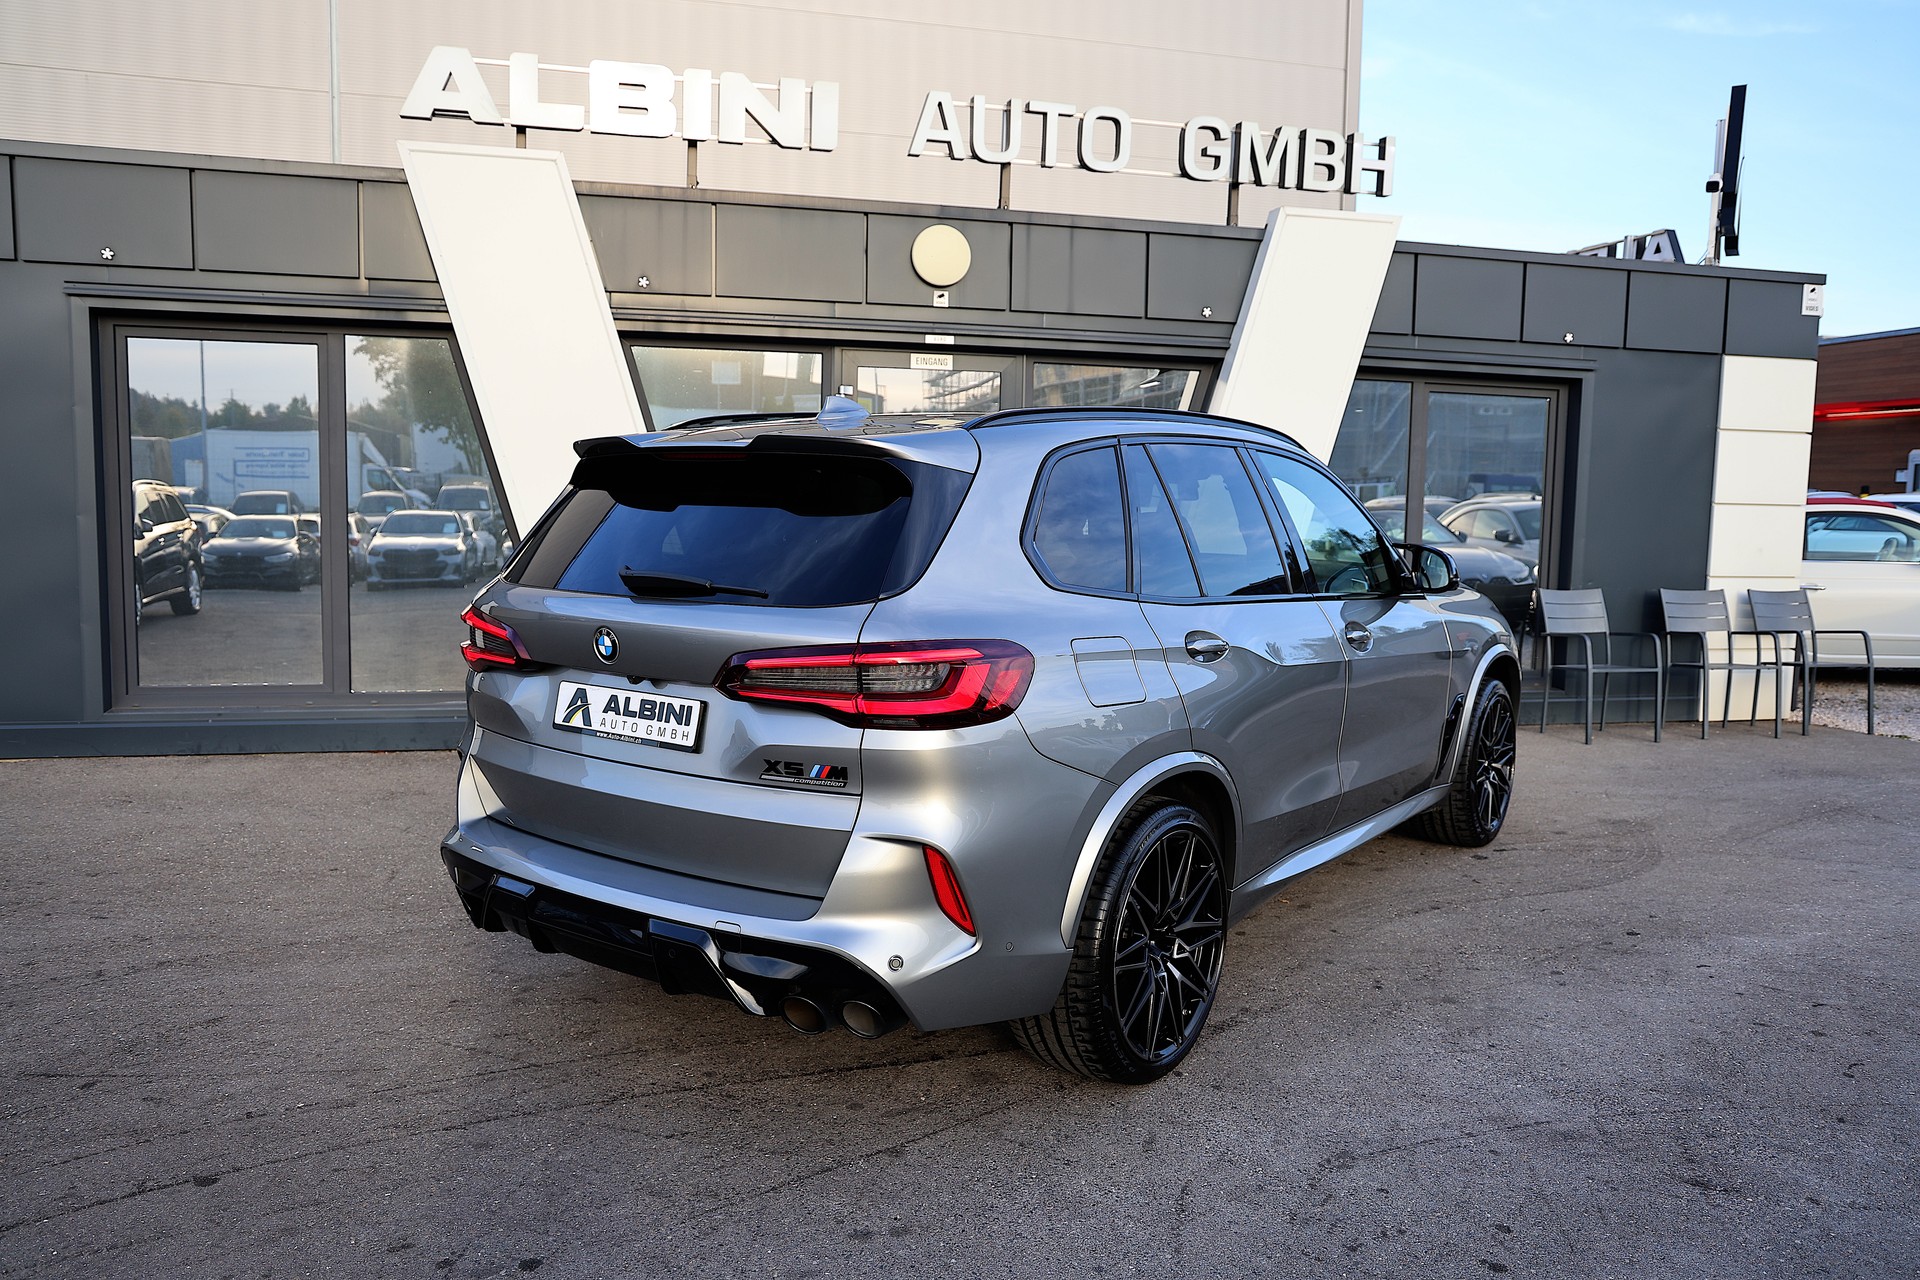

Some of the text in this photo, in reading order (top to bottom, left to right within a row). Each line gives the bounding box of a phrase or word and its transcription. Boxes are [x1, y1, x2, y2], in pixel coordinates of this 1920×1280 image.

[399, 45, 1397, 198] ALBINI AUTO GMBH
[915, 356, 949, 367] EINGANG
[602, 694, 693, 727] ALBINI
[599, 717, 690, 742] AUTO GMBH
[762, 758, 805, 777] X5
[793, 778, 845, 788] competition
